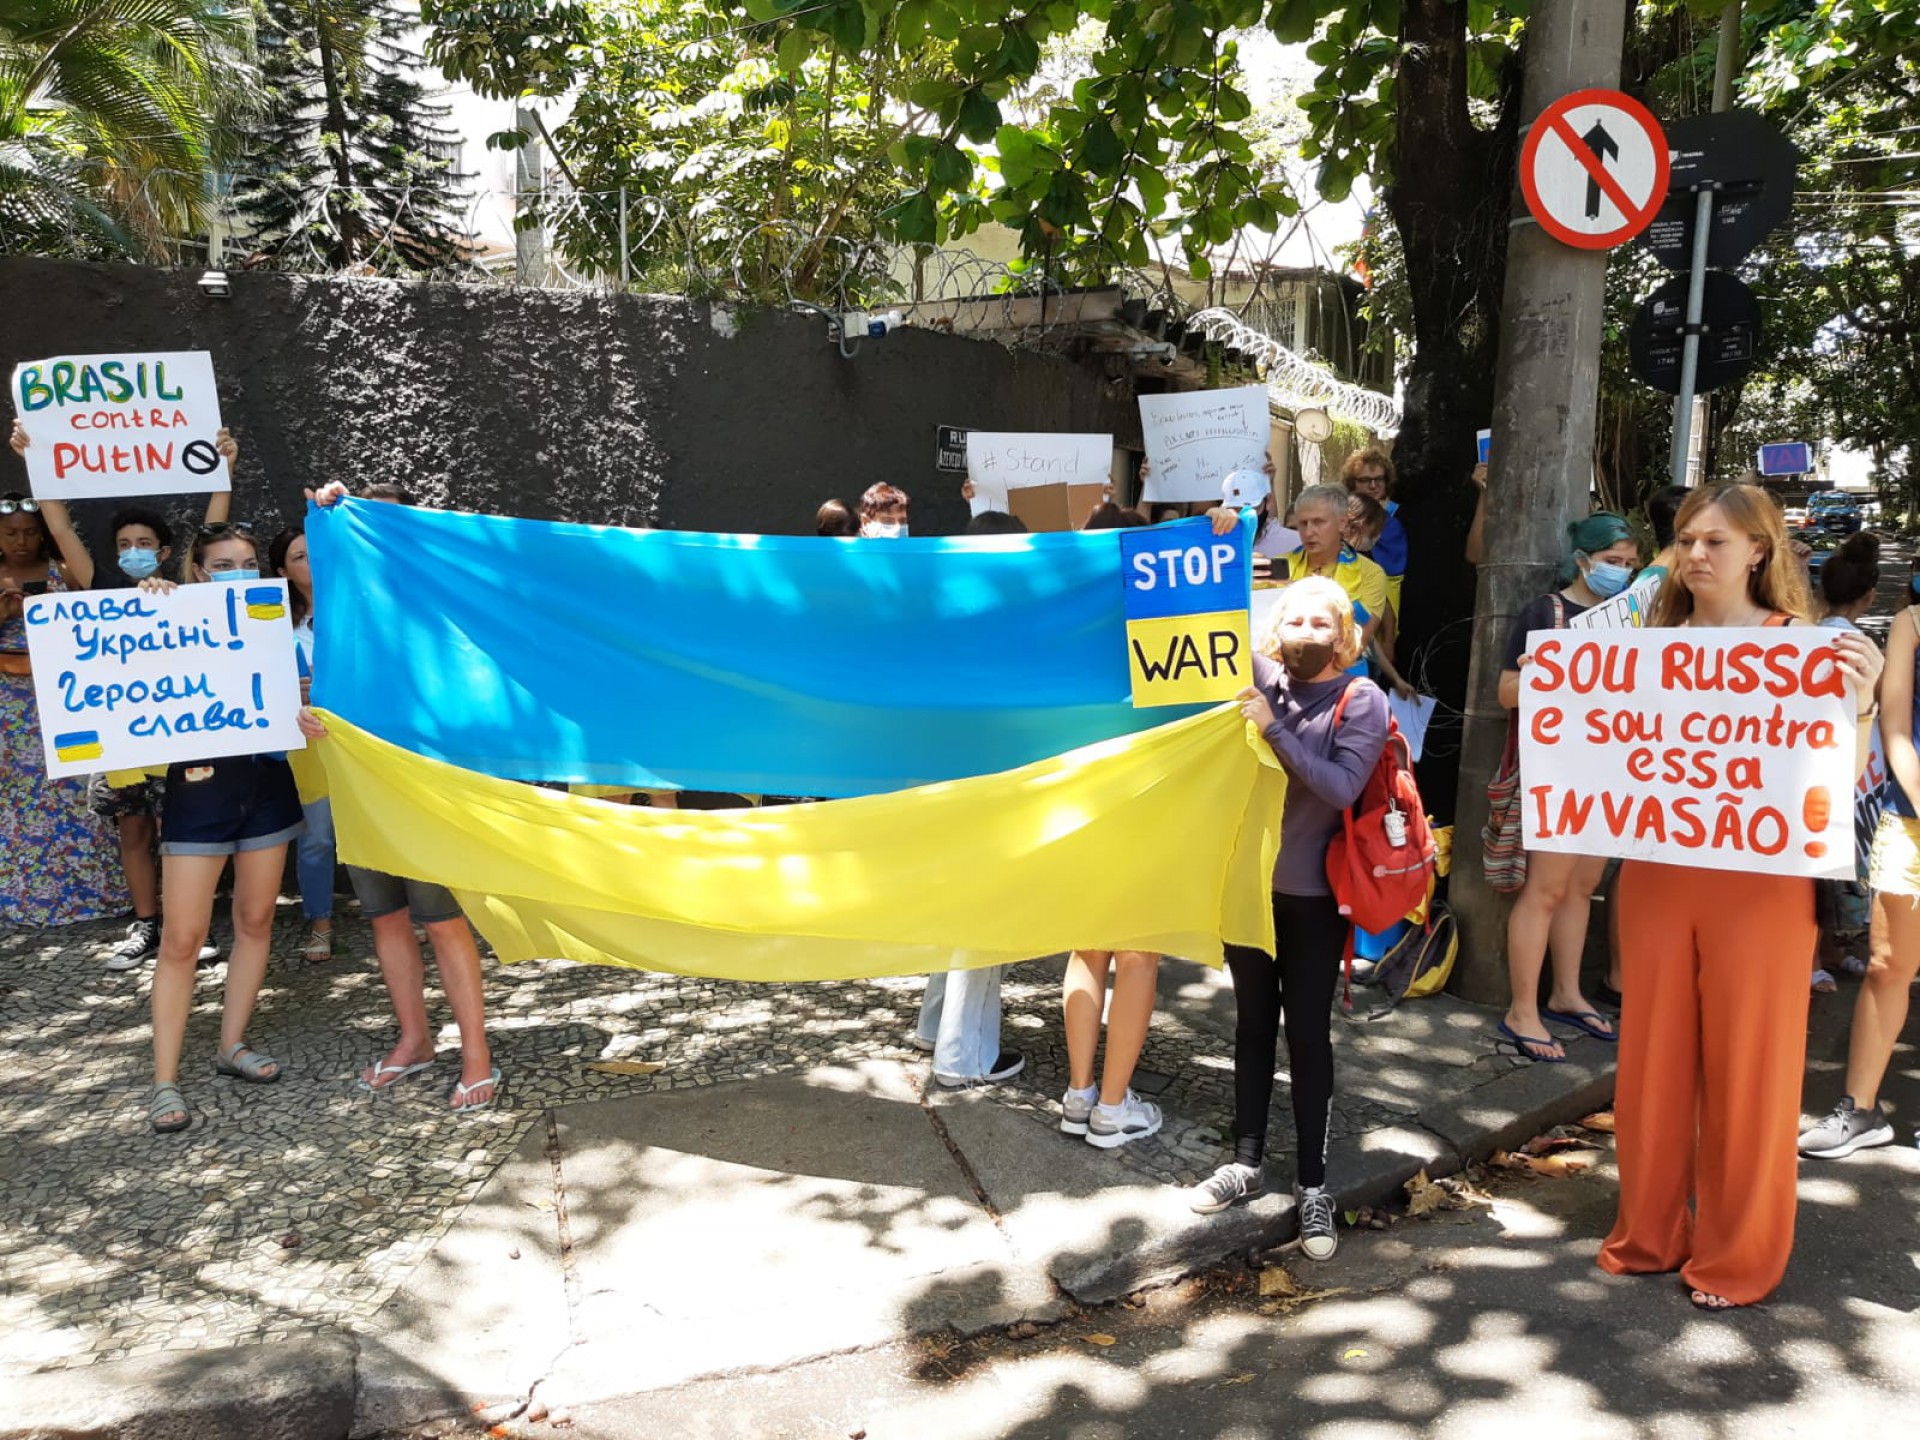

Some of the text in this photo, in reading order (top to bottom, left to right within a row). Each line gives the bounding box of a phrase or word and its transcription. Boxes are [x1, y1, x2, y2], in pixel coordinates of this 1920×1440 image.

[20, 361, 183, 411] BRASIL
[949, 431, 966, 444] RU
[1133, 544, 1236, 591] STOP
[1132, 631, 1240, 682] WAR
[1530, 640, 1639, 693] SOU
[1531, 703, 1839, 749] e sou contra
[1626, 748, 1763, 790] essa
